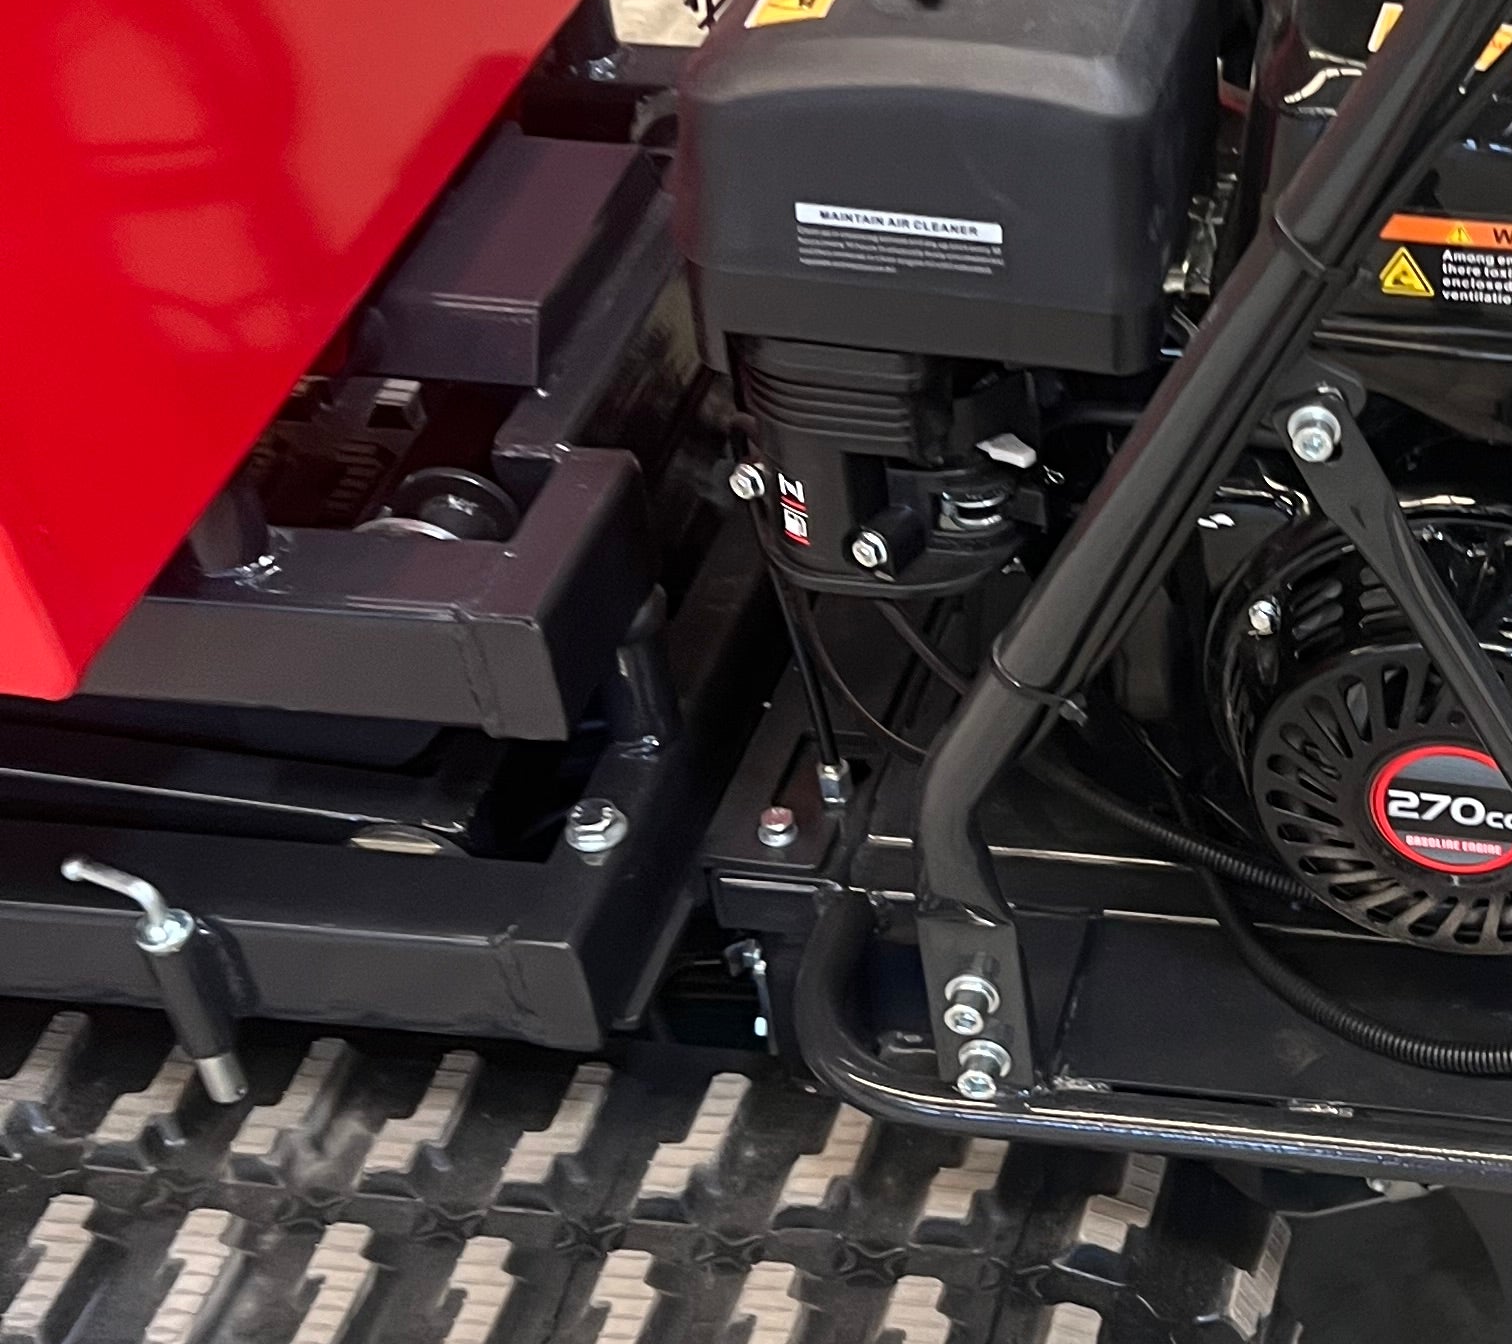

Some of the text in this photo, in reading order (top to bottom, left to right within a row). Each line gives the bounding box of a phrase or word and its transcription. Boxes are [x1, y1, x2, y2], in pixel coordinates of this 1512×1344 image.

[819, 209, 979, 237] MAINTAIN AIR CLEANER
[1442, 249, 1495, 266] Among
[1442, 262, 1481, 277] there
[1442, 276, 1512, 293] enclosed
[1405, 834, 1502, 856] GASOLINE ENGINE
